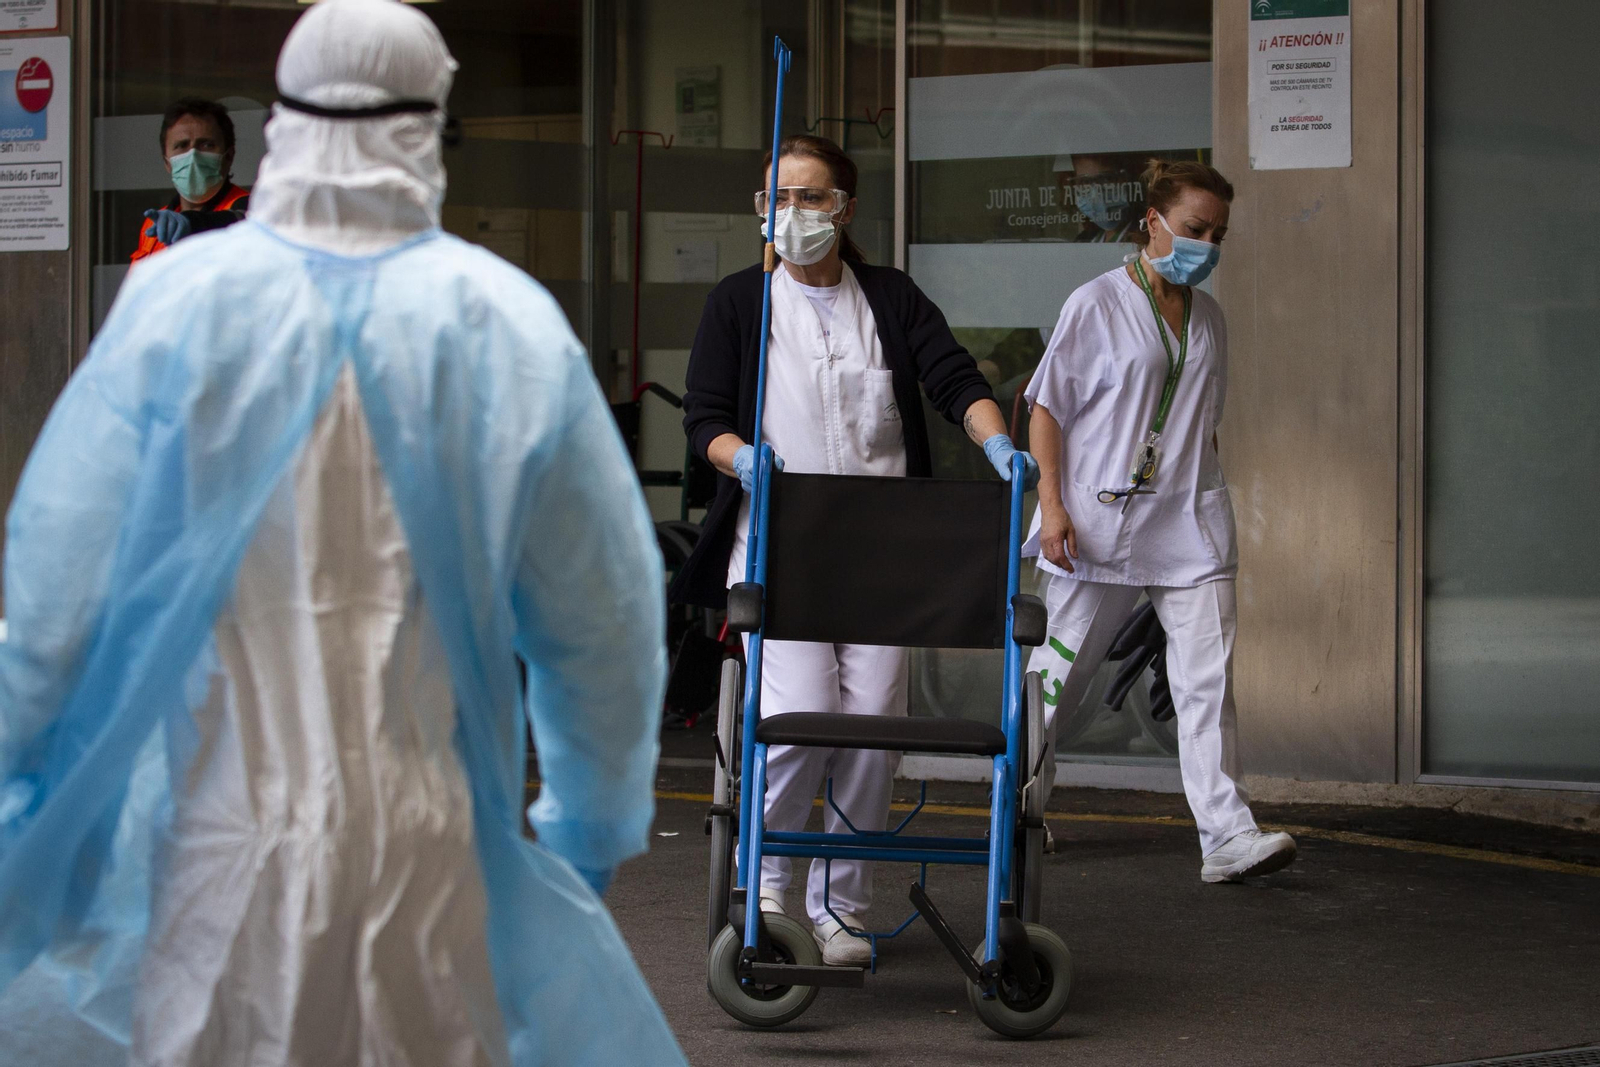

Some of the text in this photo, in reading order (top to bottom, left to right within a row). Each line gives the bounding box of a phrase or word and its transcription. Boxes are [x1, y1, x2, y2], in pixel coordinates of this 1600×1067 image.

[1269, 30, 1333, 48] ATENCIÓN
[1295, 61, 1331, 69] SEGURIDAD
[1288, 115, 1323, 123] SEGURIDAD
[1, 125, 34, 140] espacio
[15, 141, 41, 153] humo
[30, 168, 58, 182] Fumar
[986, 188, 1031, 210] JUNTA
[1039, 186, 1056, 207] DE
[1071, 211, 1087, 223] de
